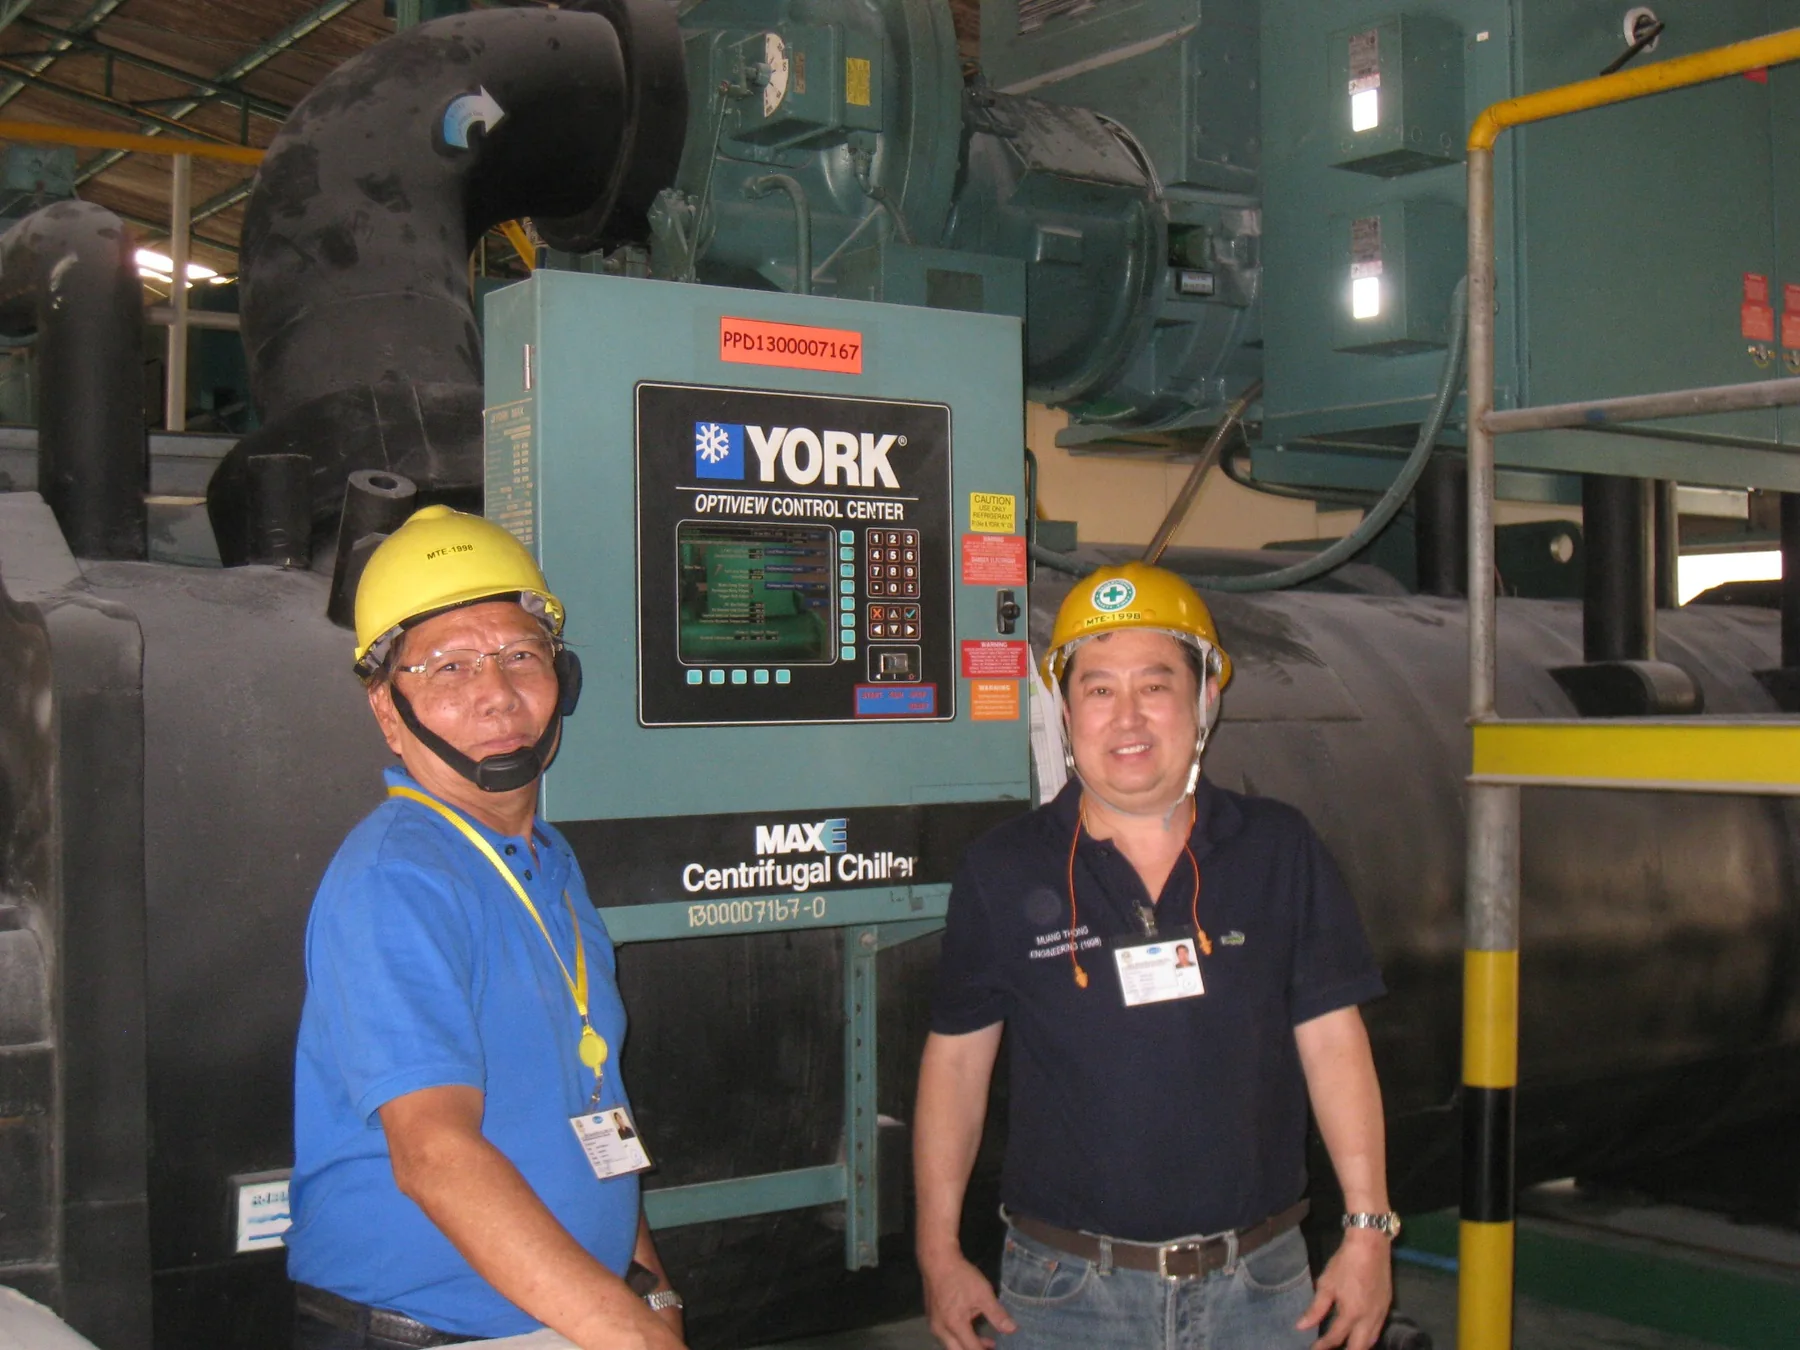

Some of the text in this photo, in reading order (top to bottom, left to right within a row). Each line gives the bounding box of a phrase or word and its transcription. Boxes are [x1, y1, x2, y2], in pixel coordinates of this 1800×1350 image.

[723, 331, 860, 360] PPD1300007167
[745, 425, 901, 488] YORK
[974, 494, 1012, 505] CAUTION
[695, 494, 904, 520] OPTIVIEW CONTROL CENTER
[972, 512, 1013, 520] REFRIGERANT
[873, 534, 913, 544] 1 2 3
[427, 544, 474, 560] MTE-1998
[872, 551, 913, 561] 4 5 6
[873, 567, 914, 577] 7 8 9
[890, 584, 897, 593] 0
[1086, 612, 1141, 626] MTE-1998
[683, 852, 916, 892] Centrifugal Chiller
[1036, 931, 1061, 945] MUANG
[1030, 942, 1079, 958] ENGINEERING
